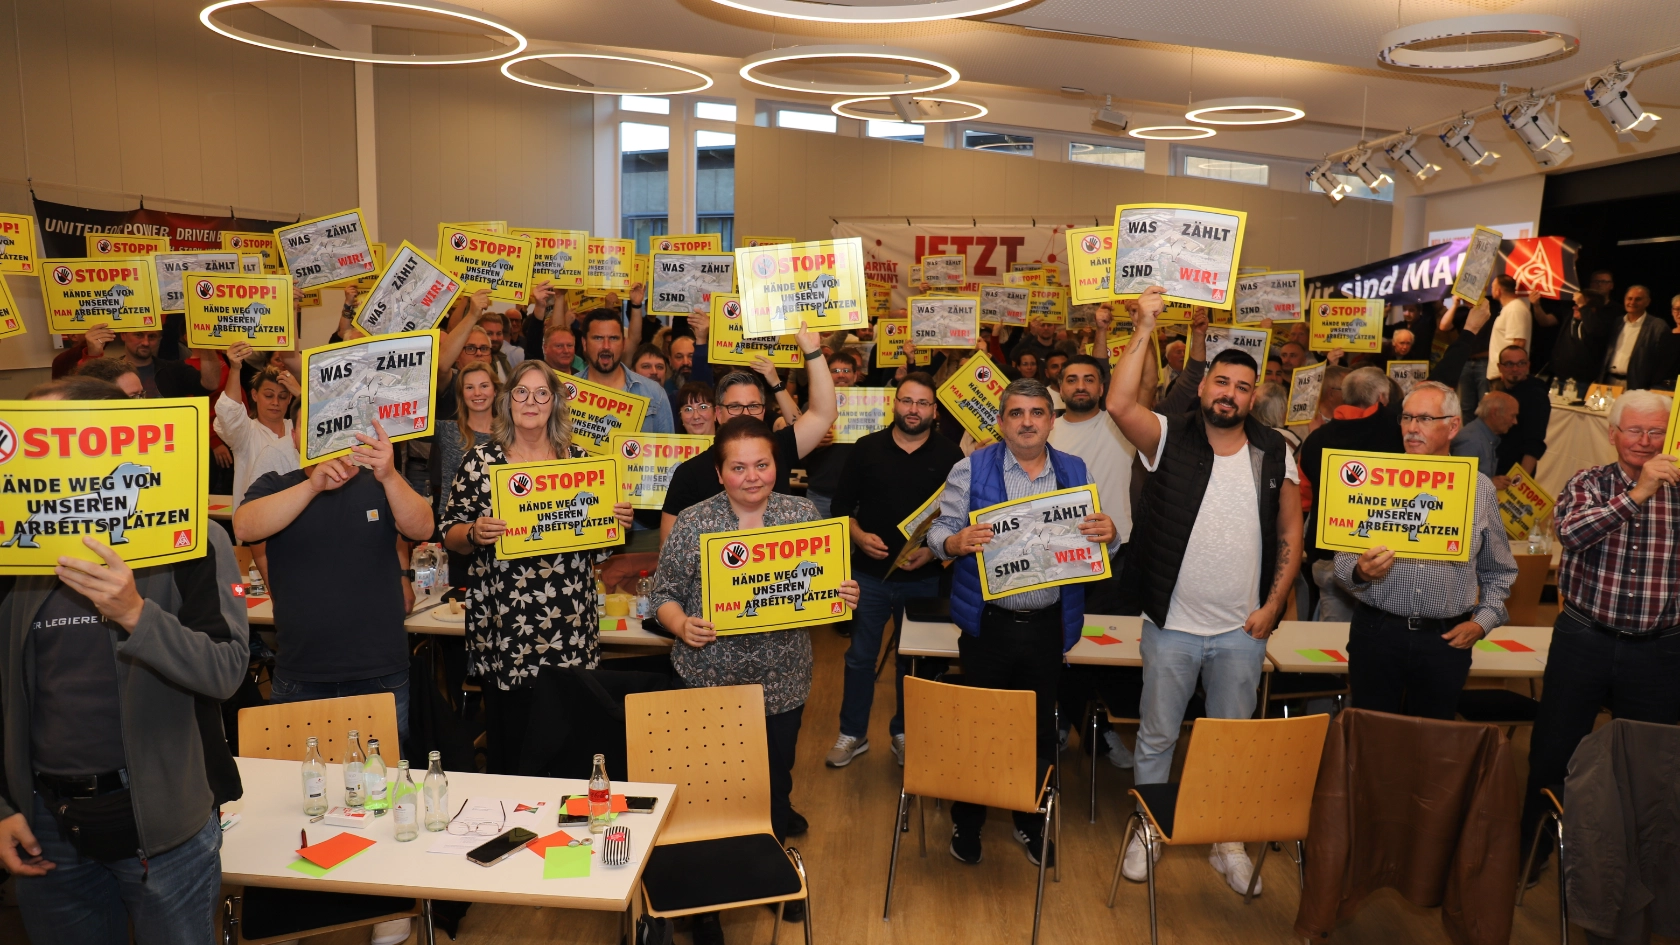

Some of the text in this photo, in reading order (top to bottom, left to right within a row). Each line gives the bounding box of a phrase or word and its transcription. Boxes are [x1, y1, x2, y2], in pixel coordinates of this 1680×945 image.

[176, 228, 216, 242] DRIVEN
[288, 222, 357, 247] WAS ZÄHLT
[1128, 221, 1231, 242] WAS ZÄHLT
[113, 243, 158, 254] STOPP!
[243, 239, 273, 249] STOPP!
[469, 238, 522, 258] STOPP!
[534, 237, 577, 250] STOPP!
[588, 244, 626, 255] STOPP!
[673, 241, 711, 251] STOPP!
[165, 263, 188, 272] WAS
[205, 259, 235, 271] ZÄHLT
[295, 252, 365, 278] SIND WIR!
[454, 255, 514, 271] HÄNDE WEG VON
[662, 262, 730, 273] WAS ZÄHLT
[778, 252, 846, 274] STOPP!
[865, 259, 898, 273] ARITÄT
[75, 268, 139, 282] STOPP!
[466, 266, 500, 277] UNSEREN
[1122, 264, 1219, 285] SIND WIR!
[763, 279, 841, 293] HÄNDE WEG VON
[1079, 277, 1098, 286] MAN
[1240, 280, 1297, 291] WAS ZÄHLT
[1341, 264, 1400, 299] sind
[63, 289, 92, 298] HÄNDE
[116, 289, 134, 297] VON
[216, 284, 277, 299] STOPP!
[367, 301, 387, 326] WAS
[391, 256, 418, 291] ZÄHLT
[420, 279, 445, 308] WIR!
[659, 293, 685, 302] SIND
[781, 290, 825, 302] UNSEREN
[1007, 292, 1026, 300] ZÄHLT
[1031, 290, 1060, 299] STOPP!
[79, 299, 119, 307] UNSEREN
[204, 304, 229, 314] HÄNDE
[750, 299, 857, 316] MAN ARBEITSPLÄTZEN
[948, 305, 973, 314] ZÄHLT
[1240, 303, 1295, 314] SIND WIR!
[54, 307, 72, 316] MAN
[1331, 306, 1373, 317] STOPP!
[217, 315, 256, 323] UNSEREN
[194, 323, 211, 331] MAN
[950, 329, 971, 337] WIR!
[716, 340, 799, 351] MAN ARBEITSPLÄTZEN
[1205, 334, 1219, 342] AS
[1233, 336, 1263, 347] ZÄHLT
[320, 350, 426, 384] WAS ZÄHLT
[1298, 377, 1311, 386] WAS
[1394, 370, 1408, 379] WAS
[949, 384, 964, 399] MAN
[968, 382, 988, 403] HÄNDE
[985, 401, 999, 415] WEG
[577, 390, 634, 417] STOPP!
[848, 395, 890, 406] STOPP!
[1292, 403, 1307, 412] SIND
[971, 396, 996, 423] UNSEREN
[316, 400, 418, 438] SIND WIR!
[588, 413, 622, 429] WEG VON
[23, 423, 175, 459] STOPP!
[627, 463, 655, 473] HÄNDE
[0, 472, 161, 493] ÄNDE WEG VON
[535, 469, 605, 492] STOPP!
[1370, 467, 1455, 490] STOPP!
[621, 482, 632, 490] AN
[1348, 493, 1444, 510] HÄNDE WEG VON
[1518, 482, 1547, 511] STOPP!
[27, 495, 127, 514] UNSEREN
[518, 496, 599, 512] HÄNDE WEG VON
[14, 508, 190, 536] ARBEITSPLÄTZEN
[537, 508, 583, 522] UNSEREN
[991, 504, 1088, 536] WAS ZÄHLT
[1367, 509, 1422, 521] UNSEREN
[505, 514, 615, 537] MAN ARBEITSPLÄTZEN
[1329, 517, 1459, 536] MAN ARBEITSPLÄTZEN
[752, 534, 831, 563] STOPP!
[995, 546, 1092, 578] SIND WIR!
[732, 566, 824, 586] HÄNDE WEG VON
[752, 580, 805, 596] UNSEREN
[715, 601, 741, 613] MAN
[45, 615, 98, 628] LEGIERE
